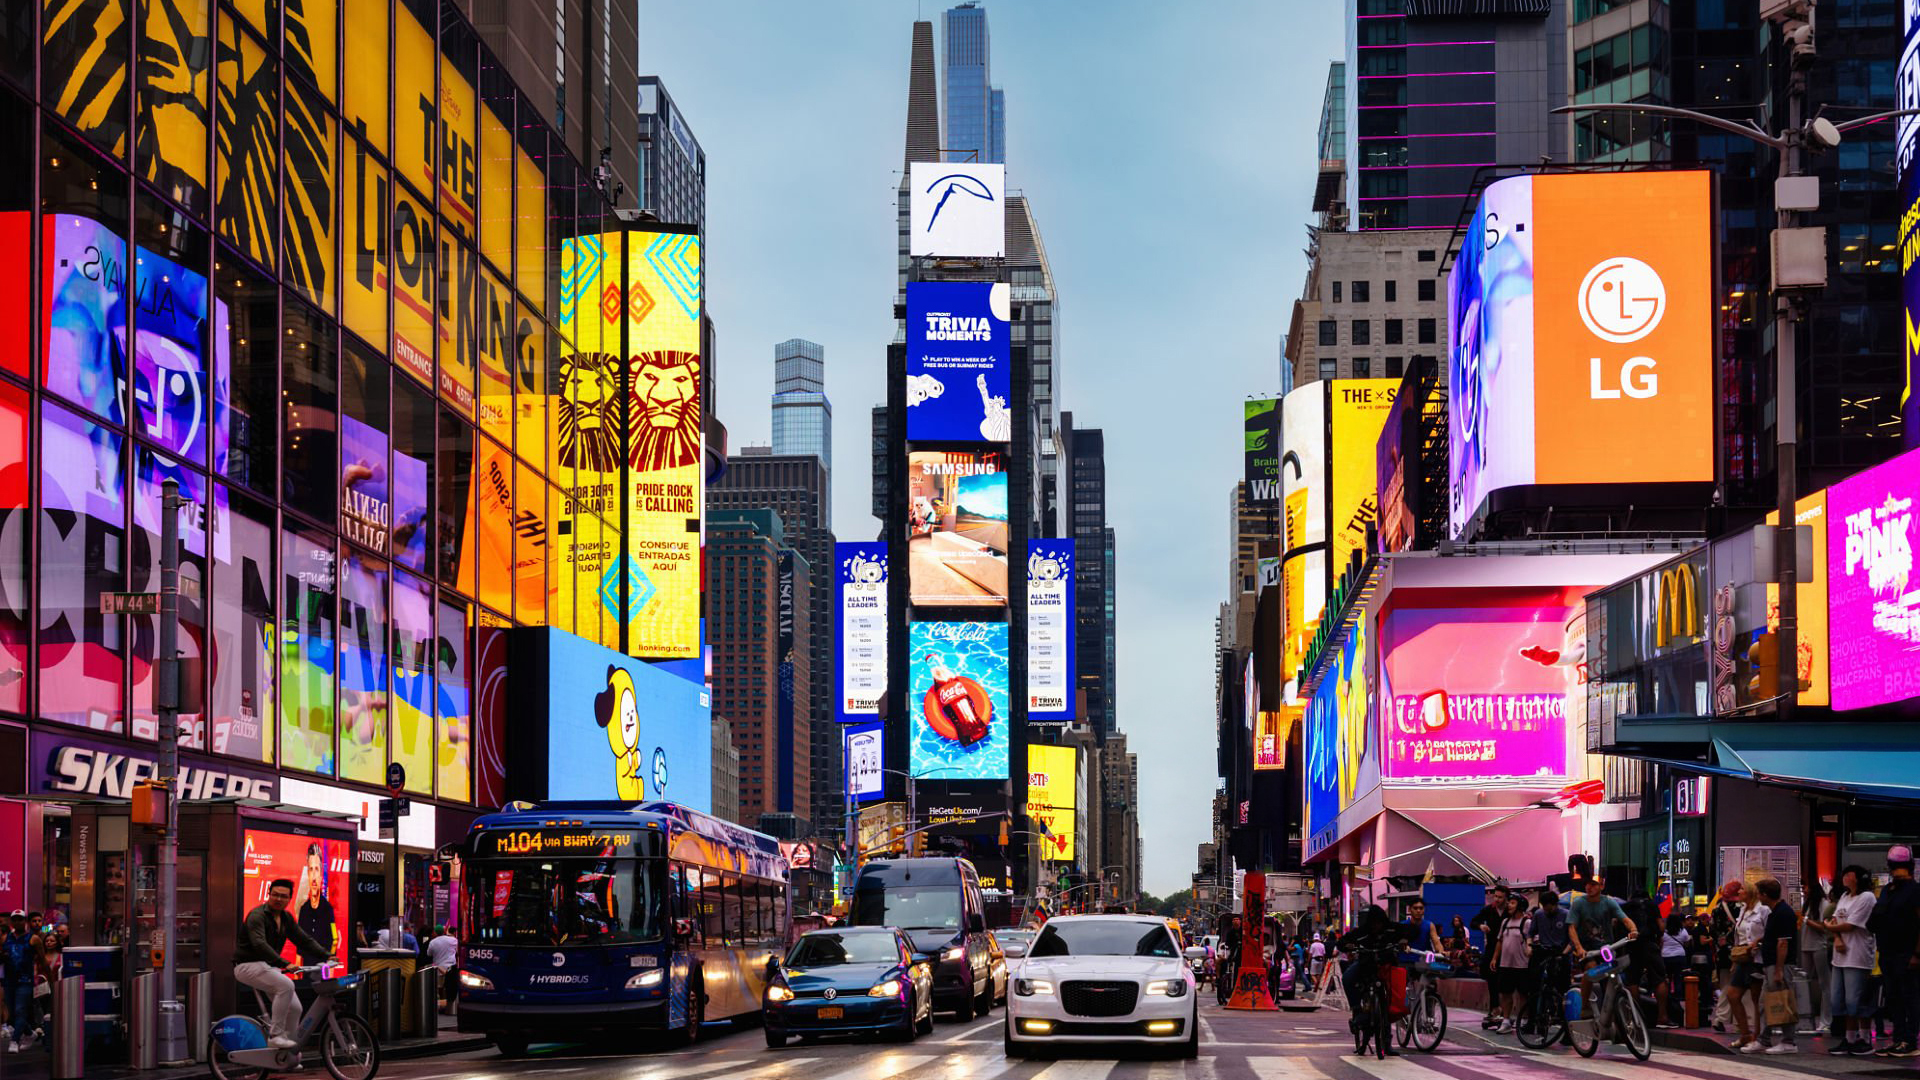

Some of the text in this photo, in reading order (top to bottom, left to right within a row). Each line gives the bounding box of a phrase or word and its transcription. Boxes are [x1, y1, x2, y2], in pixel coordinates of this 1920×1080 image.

[420, 92, 474, 210] THE
[356, 115, 450, 321] LION
[456, 219, 535, 394] KING
[926, 317, 991, 331] TRIVIA
[926, 331, 991, 341] MOMENTS
[396, 338, 433, 377] ENTRANCE
[441, 373, 453, 394] ON
[1589, 355, 1658, 400] LG
[1342, 388, 1372, 403] THE
[922, 462, 996, 476] SAMSUNG
[636, 483, 693, 498] PRIDE ROCK
[636, 497, 694, 513] IS CALLING
[1845, 507, 1872, 536] THE
[639, 541, 689, 551] CONSIGUE
[1845, 513, 1912, 577] PINK
[638, 551, 691, 561] ENTRADAS
[652, 562, 677, 571] AQUÍ
[115, 595, 125, 611] W
[128, 595, 143, 611] 44
[638, 644, 691, 653] lionking.com
[1831, 664, 1882, 690] SAUCEPANS
[52, 746, 274, 802] SKEHERS
[929, 806, 983, 815] HeGetsUs.com/
[497, 831, 631, 852] M104 VIA BWAY/7 AV
[79, 825, 90, 884] Newsstand
[361, 850, 385, 864] TISSOT
[469, 949, 493, 960] 9455
[537, 975, 589, 984] HYBRIDBUS
